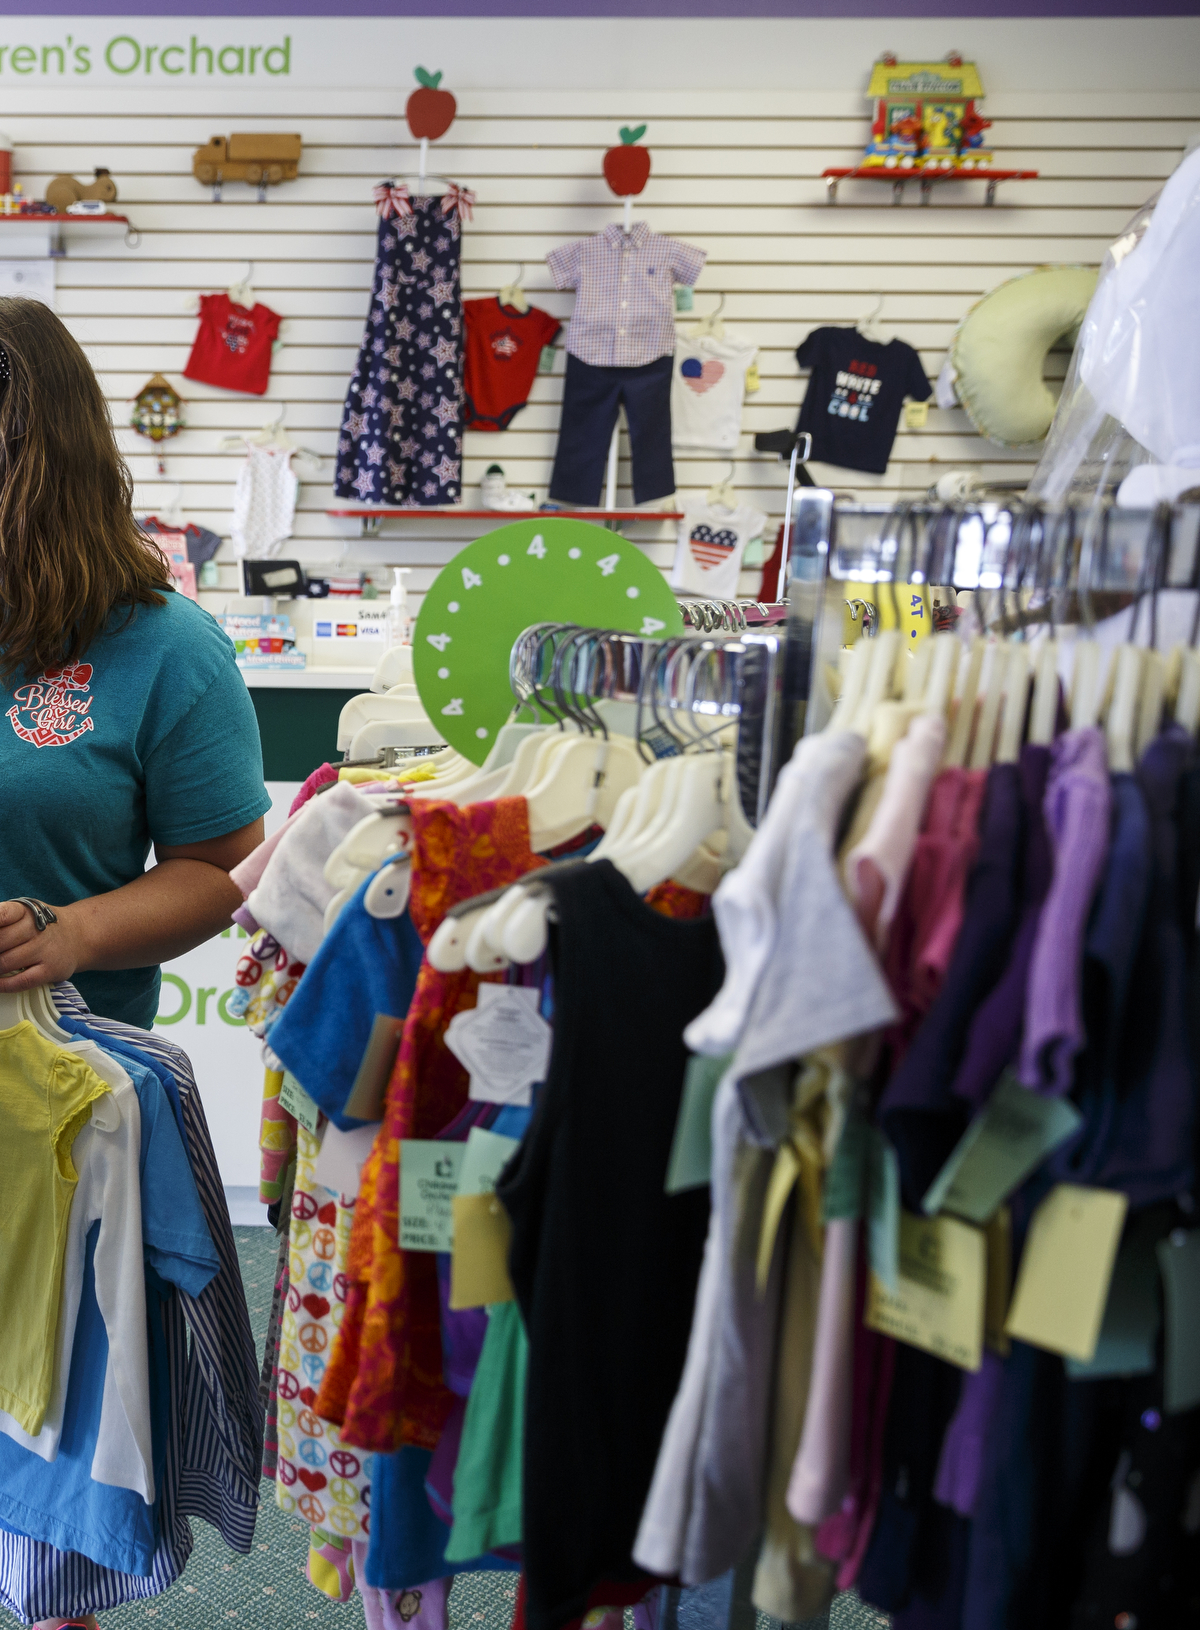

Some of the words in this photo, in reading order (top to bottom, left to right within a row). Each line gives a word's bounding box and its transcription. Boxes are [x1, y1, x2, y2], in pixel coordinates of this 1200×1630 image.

[104, 34, 292, 76] Orchard
[835, 370, 882, 395] WHITE
[827, 399, 869, 422] COOL
[526, 533, 548, 559] 4
[596, 553, 620, 577] 4
[461, 566, 483, 590] 4
[910, 594, 923, 619] 4T
[361, 627, 380, 635] VISA
[640, 616, 666, 635] 4
[426, 631, 451, 652] 4
[13, 684, 94, 715] Blessed
[441, 697, 464, 715] 4
[30, 707, 76, 731] Girl
[280, 1095, 296, 1115] PRICE:
[402, 1232, 438, 1245] PRICE:
